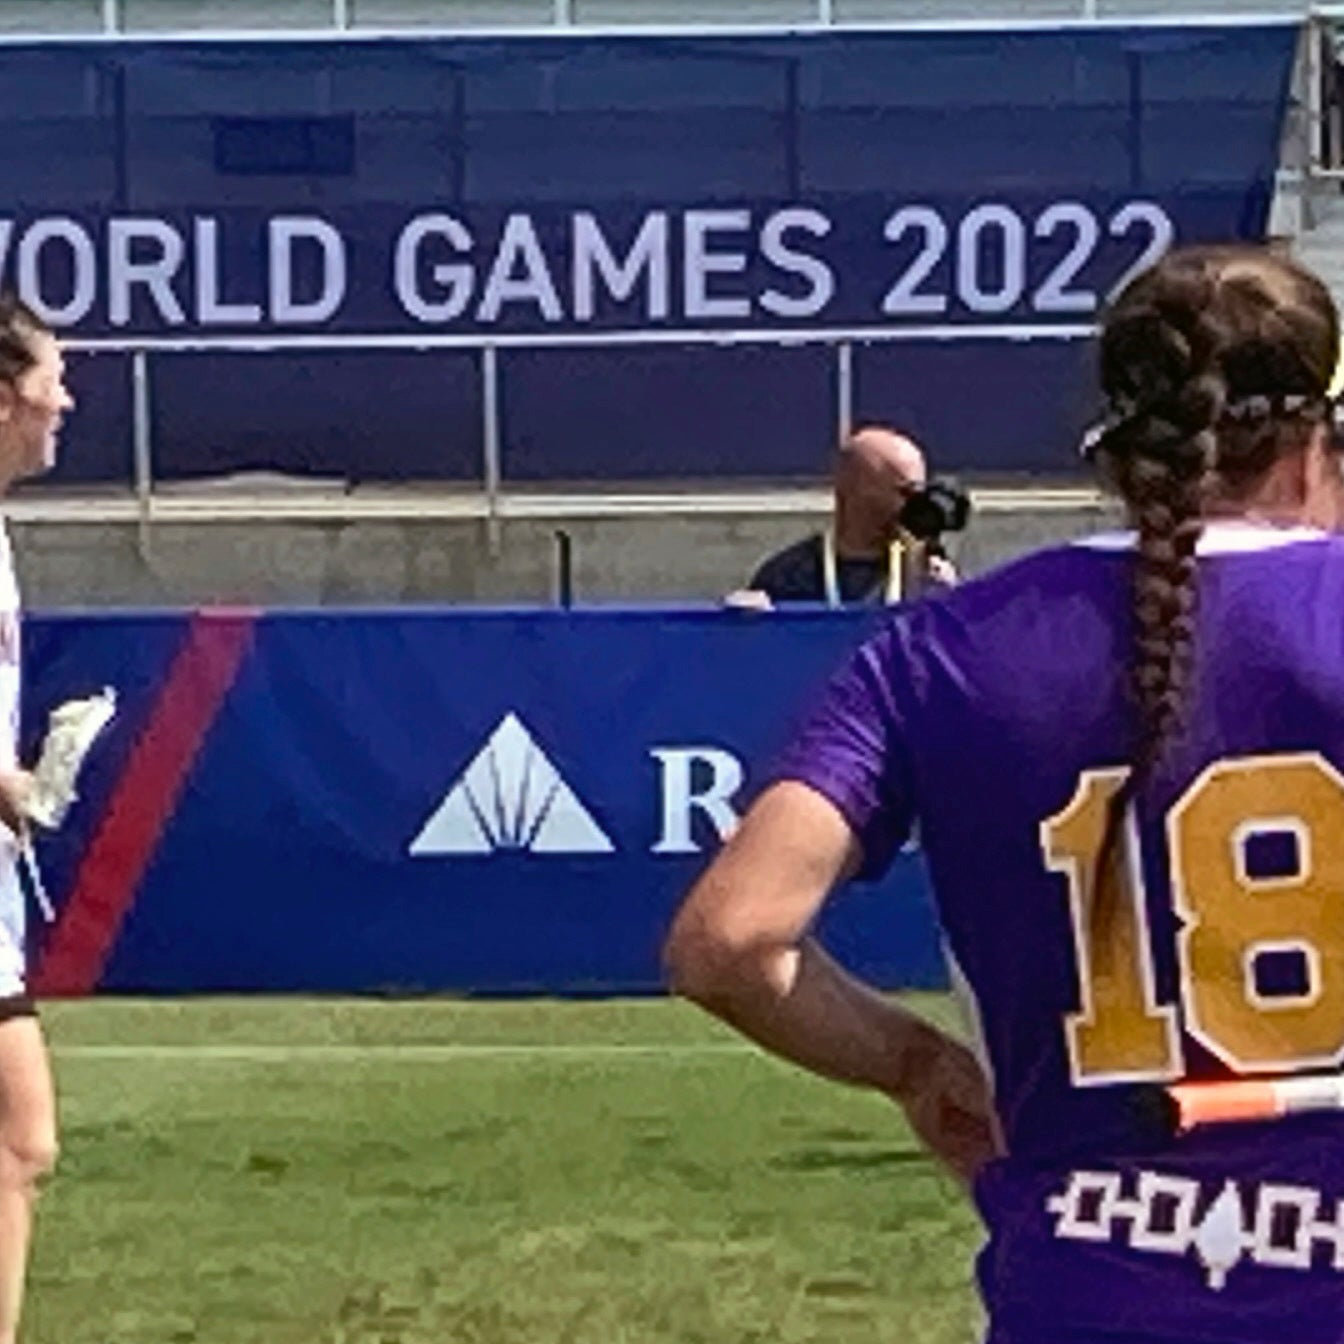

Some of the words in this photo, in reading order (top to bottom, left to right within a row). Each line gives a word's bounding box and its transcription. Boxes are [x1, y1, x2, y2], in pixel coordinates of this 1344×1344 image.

[394, 208, 835, 323] GAMES
[882, 200, 1175, 314] 2022
[648, 746, 743, 853] R
